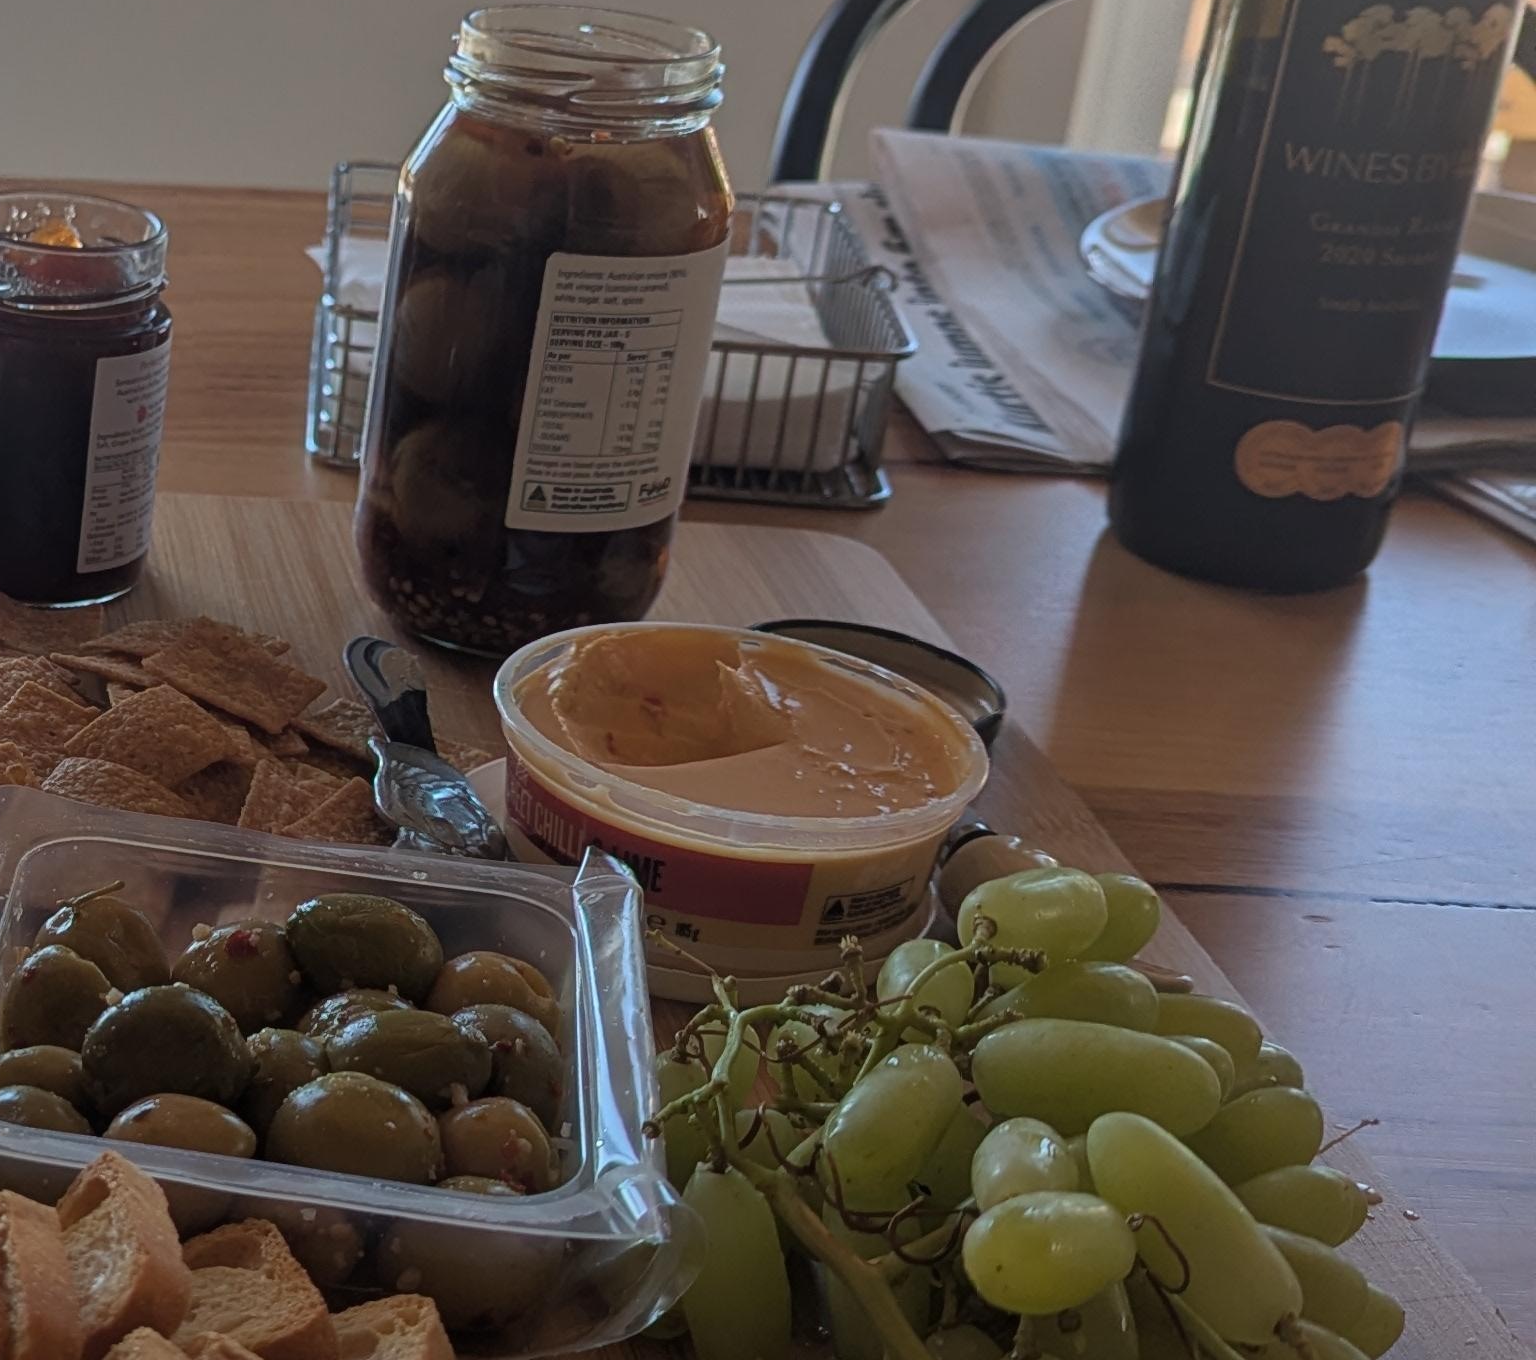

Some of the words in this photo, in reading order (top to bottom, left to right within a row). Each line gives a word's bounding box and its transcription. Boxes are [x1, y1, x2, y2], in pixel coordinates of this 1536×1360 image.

[1284, 139, 1412, 186] WINES
[552, 314, 597, 325] NUTRITION
[597, 316, 651, 325] INFORMATION
[551, 328, 586, 338] SERVING
[585, 329, 602, 338] PER
[602, 330, 619, 339] JAR
[549, 338, 584, 348] SERVING
[584, 339, 602, 349] SIZE
[542, 375, 574, 385] PROTEIN
[534, 801, 587, 861] CHILLI
